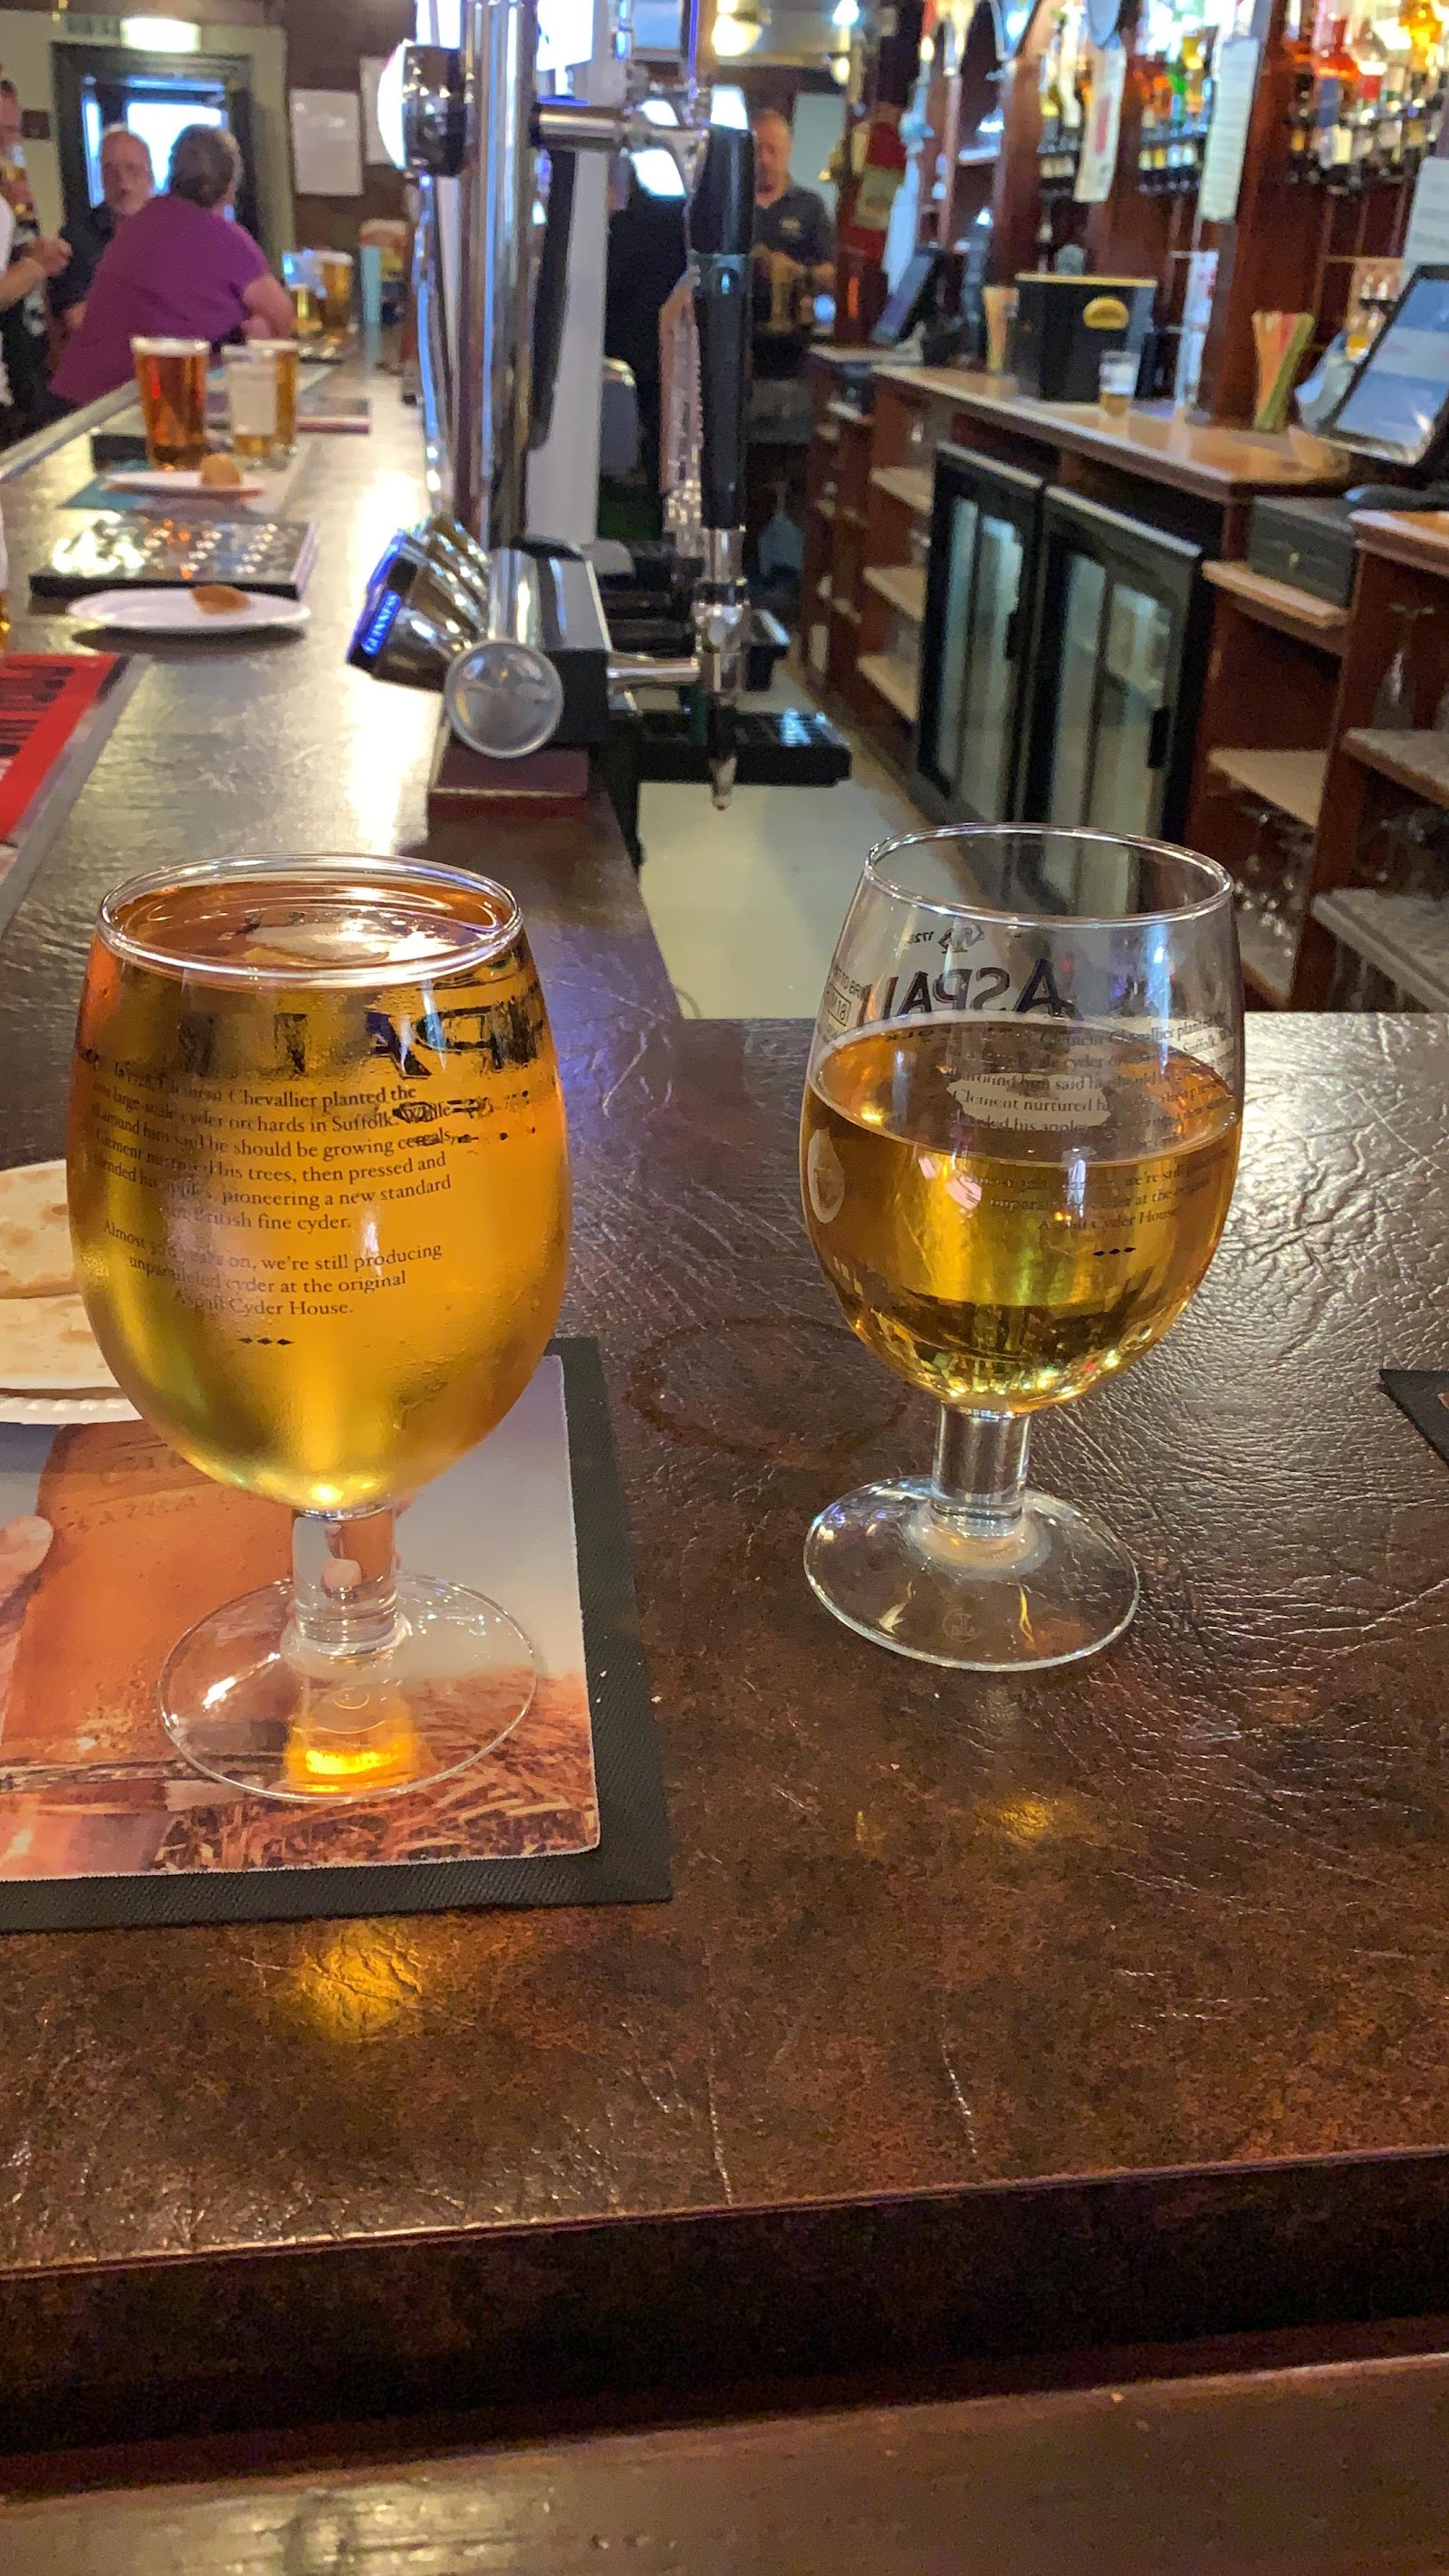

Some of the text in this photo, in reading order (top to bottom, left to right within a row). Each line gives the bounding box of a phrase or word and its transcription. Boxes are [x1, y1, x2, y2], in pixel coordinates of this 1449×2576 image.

[1055, 1076, 1084, 1091] said
[228, 1089, 317, 1109] Chevallier
[322, 1086, 387, 1114] planted
[389, 1084, 417, 1101] the
[954, 1087, 1019, 1110] Clement
[1023, 1098, 1092, 1113] nurtured
[228, 1114, 305, 1133] orchards
[310, 1116, 327, 1133] in
[332, 1110, 399, 1133] Suffolk.
[233, 1139, 292, 1158] should
[297, 1141, 319, 1158] be
[322, 1139, 395, 1162] growing
[248, 1166, 297, 1184] trees,
[302, 1167, 343, 1183] then
[349, 1158, 413, 1185] pressed
[417, 1150, 447, 1172] and
[221, 1189, 320, 1211] pioneering
[323, 1193, 334, 1206] a
[339, 1190, 377, 1206] new
[379, 1174, 452, 1201] standard
[257, 1213, 293, 1230] fine
[296, 1214, 352, 1235] cyder.
[102, 1218, 147, 1249] Almost
[228, 1255, 257, 1271] on,
[260, 1255, 310, 1271] we're
[313, 1254, 349, 1271] still
[353, 1244, 443, 1273] producing
[226, 1276, 275, 1295] cyder
[280, 1280, 297, 1294] at
[302, 1277, 333, 1293] the
[337, 1269, 408, 1294] original
[228, 1296, 285, 1318] Cyder
[289, 1300, 354, 1316] House.
